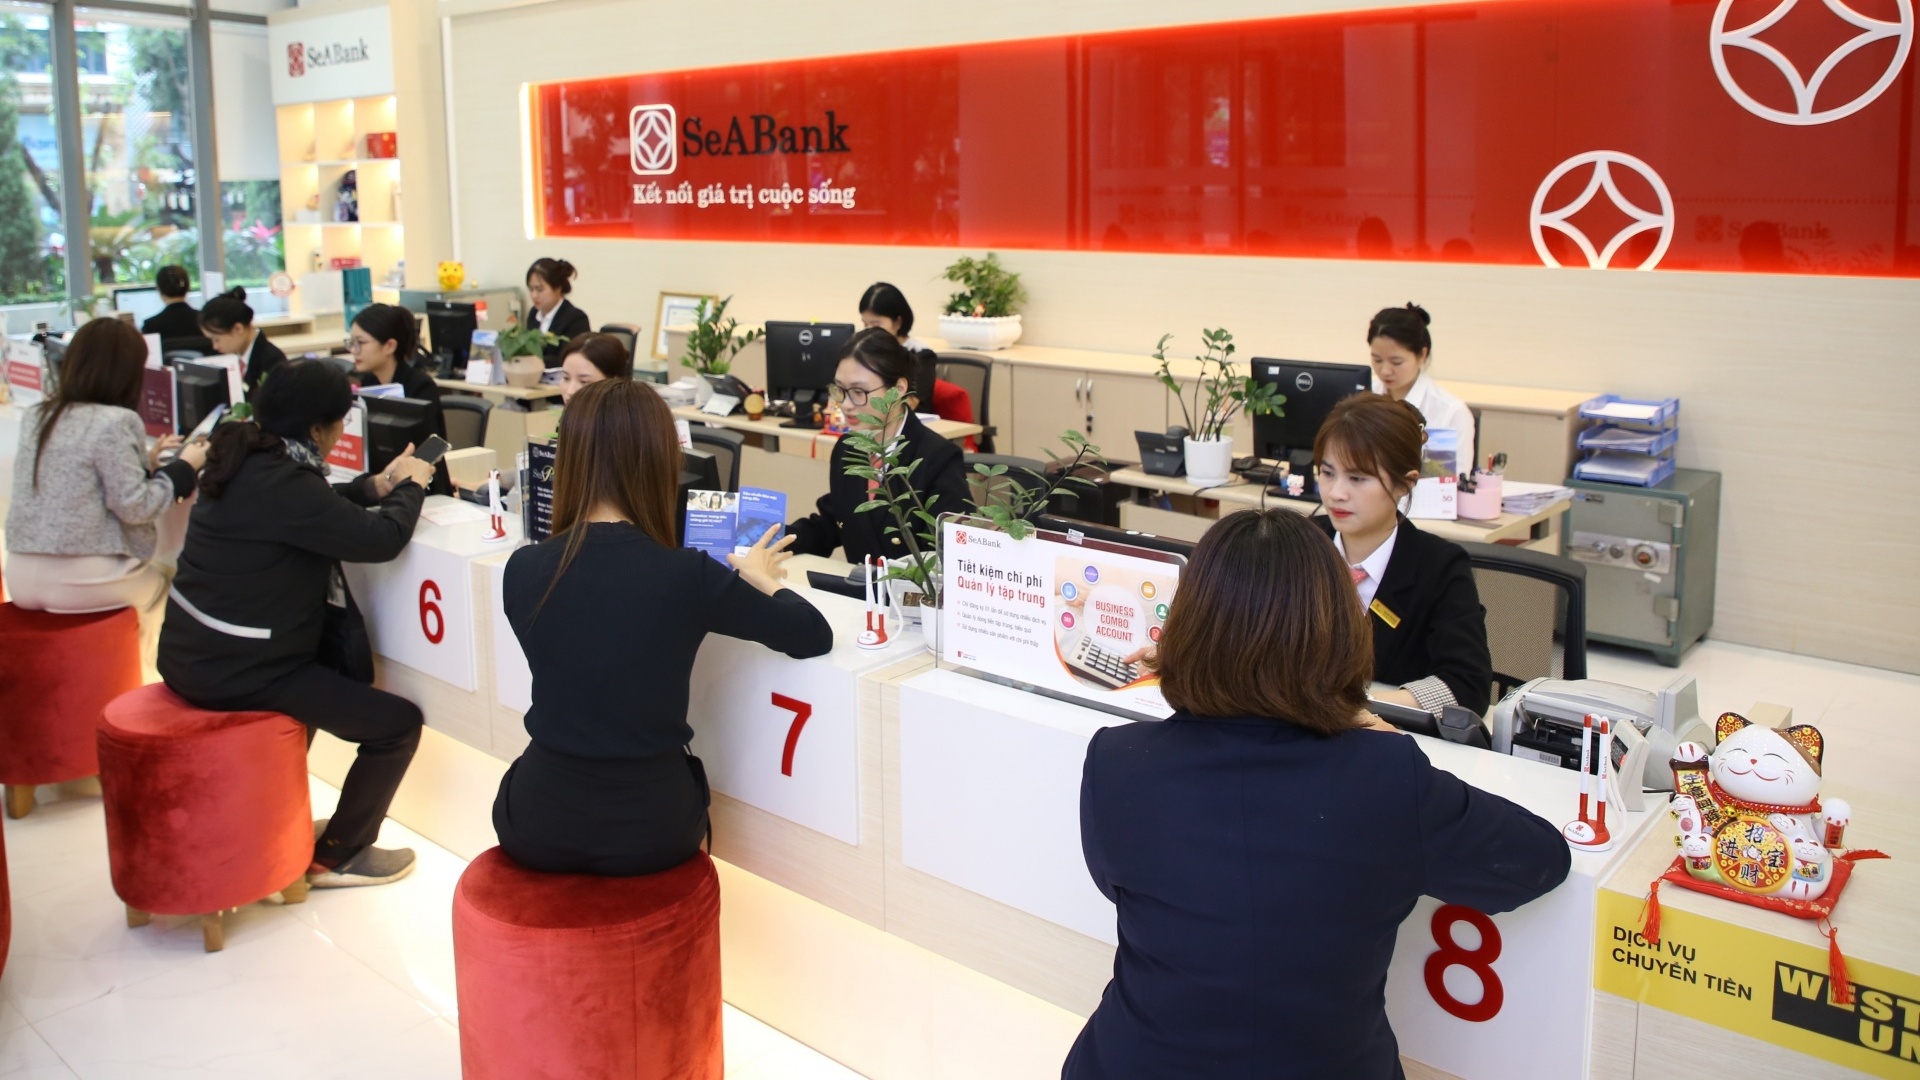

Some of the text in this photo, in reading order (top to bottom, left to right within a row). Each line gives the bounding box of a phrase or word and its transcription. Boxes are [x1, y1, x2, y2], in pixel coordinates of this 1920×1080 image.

[307, 38, 369, 68] SeABank
[683, 111, 850, 157] SeABank
[633, 178, 856, 209] Kết nối giá trị cuộc sống
[968, 535, 1001, 548] SeABank
[958, 559, 1042, 588] Tiết kiệm chi phí
[958, 576, 1045, 608] Quản lý tập trung
[419, 579, 444, 644] 6
[1096, 600, 1134, 618] BUSINESS
[1100, 614, 1128, 628] COMBO
[1096, 626, 1133, 642] ACCOUNT
[771, 692, 812, 777] 7
[1424, 903, 1504, 1022] 8
[1668, 941, 1696, 962] VỤ
[1612, 948, 1752, 1001] CHUYỂN TIỀN
